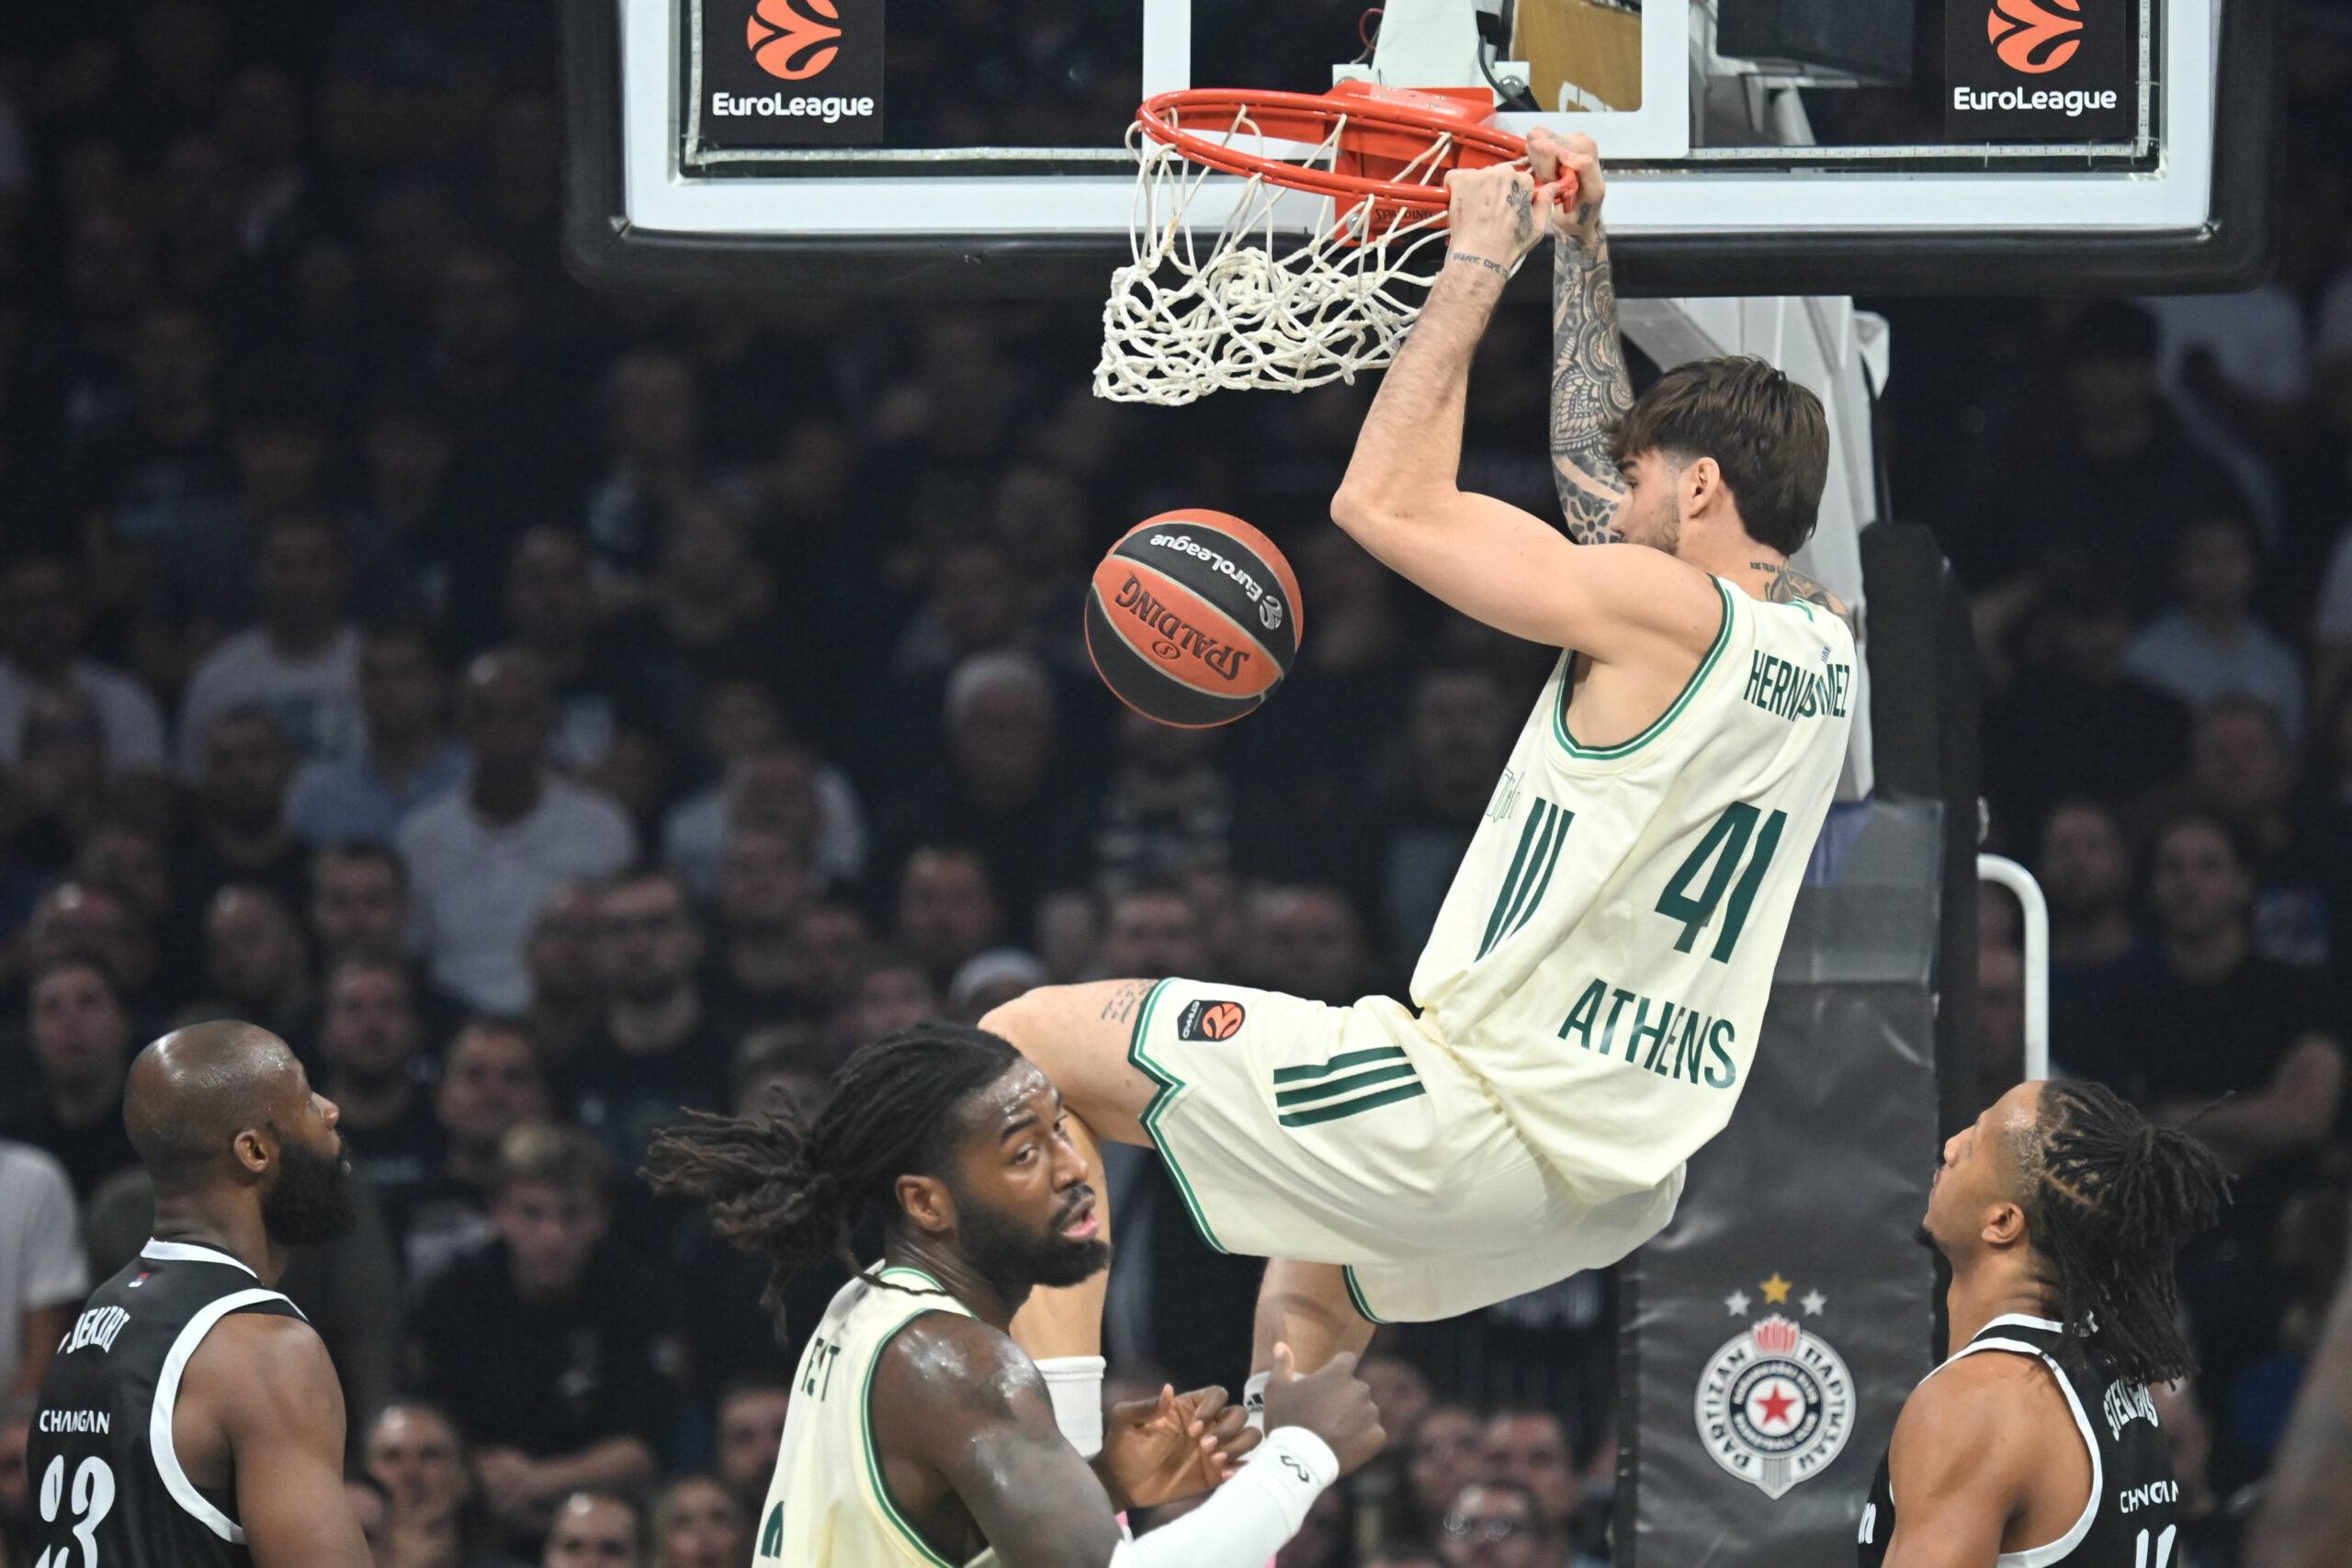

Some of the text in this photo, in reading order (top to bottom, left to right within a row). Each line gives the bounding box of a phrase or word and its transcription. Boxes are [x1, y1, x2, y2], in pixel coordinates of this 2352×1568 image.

[712, 92, 874, 124] EuroLeague
[1953, 86, 2118, 118] EuroLeague
[1374, 208, 1434, 221] SPADING
[1149, 534, 1263, 603] EuroLeague
[1114, 575, 1250, 681] SPALDING
[1654, 800, 1788, 964] 41
[1556, 977, 1737, 1089] ATHENS
[1705, 1347, 1751, 1469] PARTIZAN
